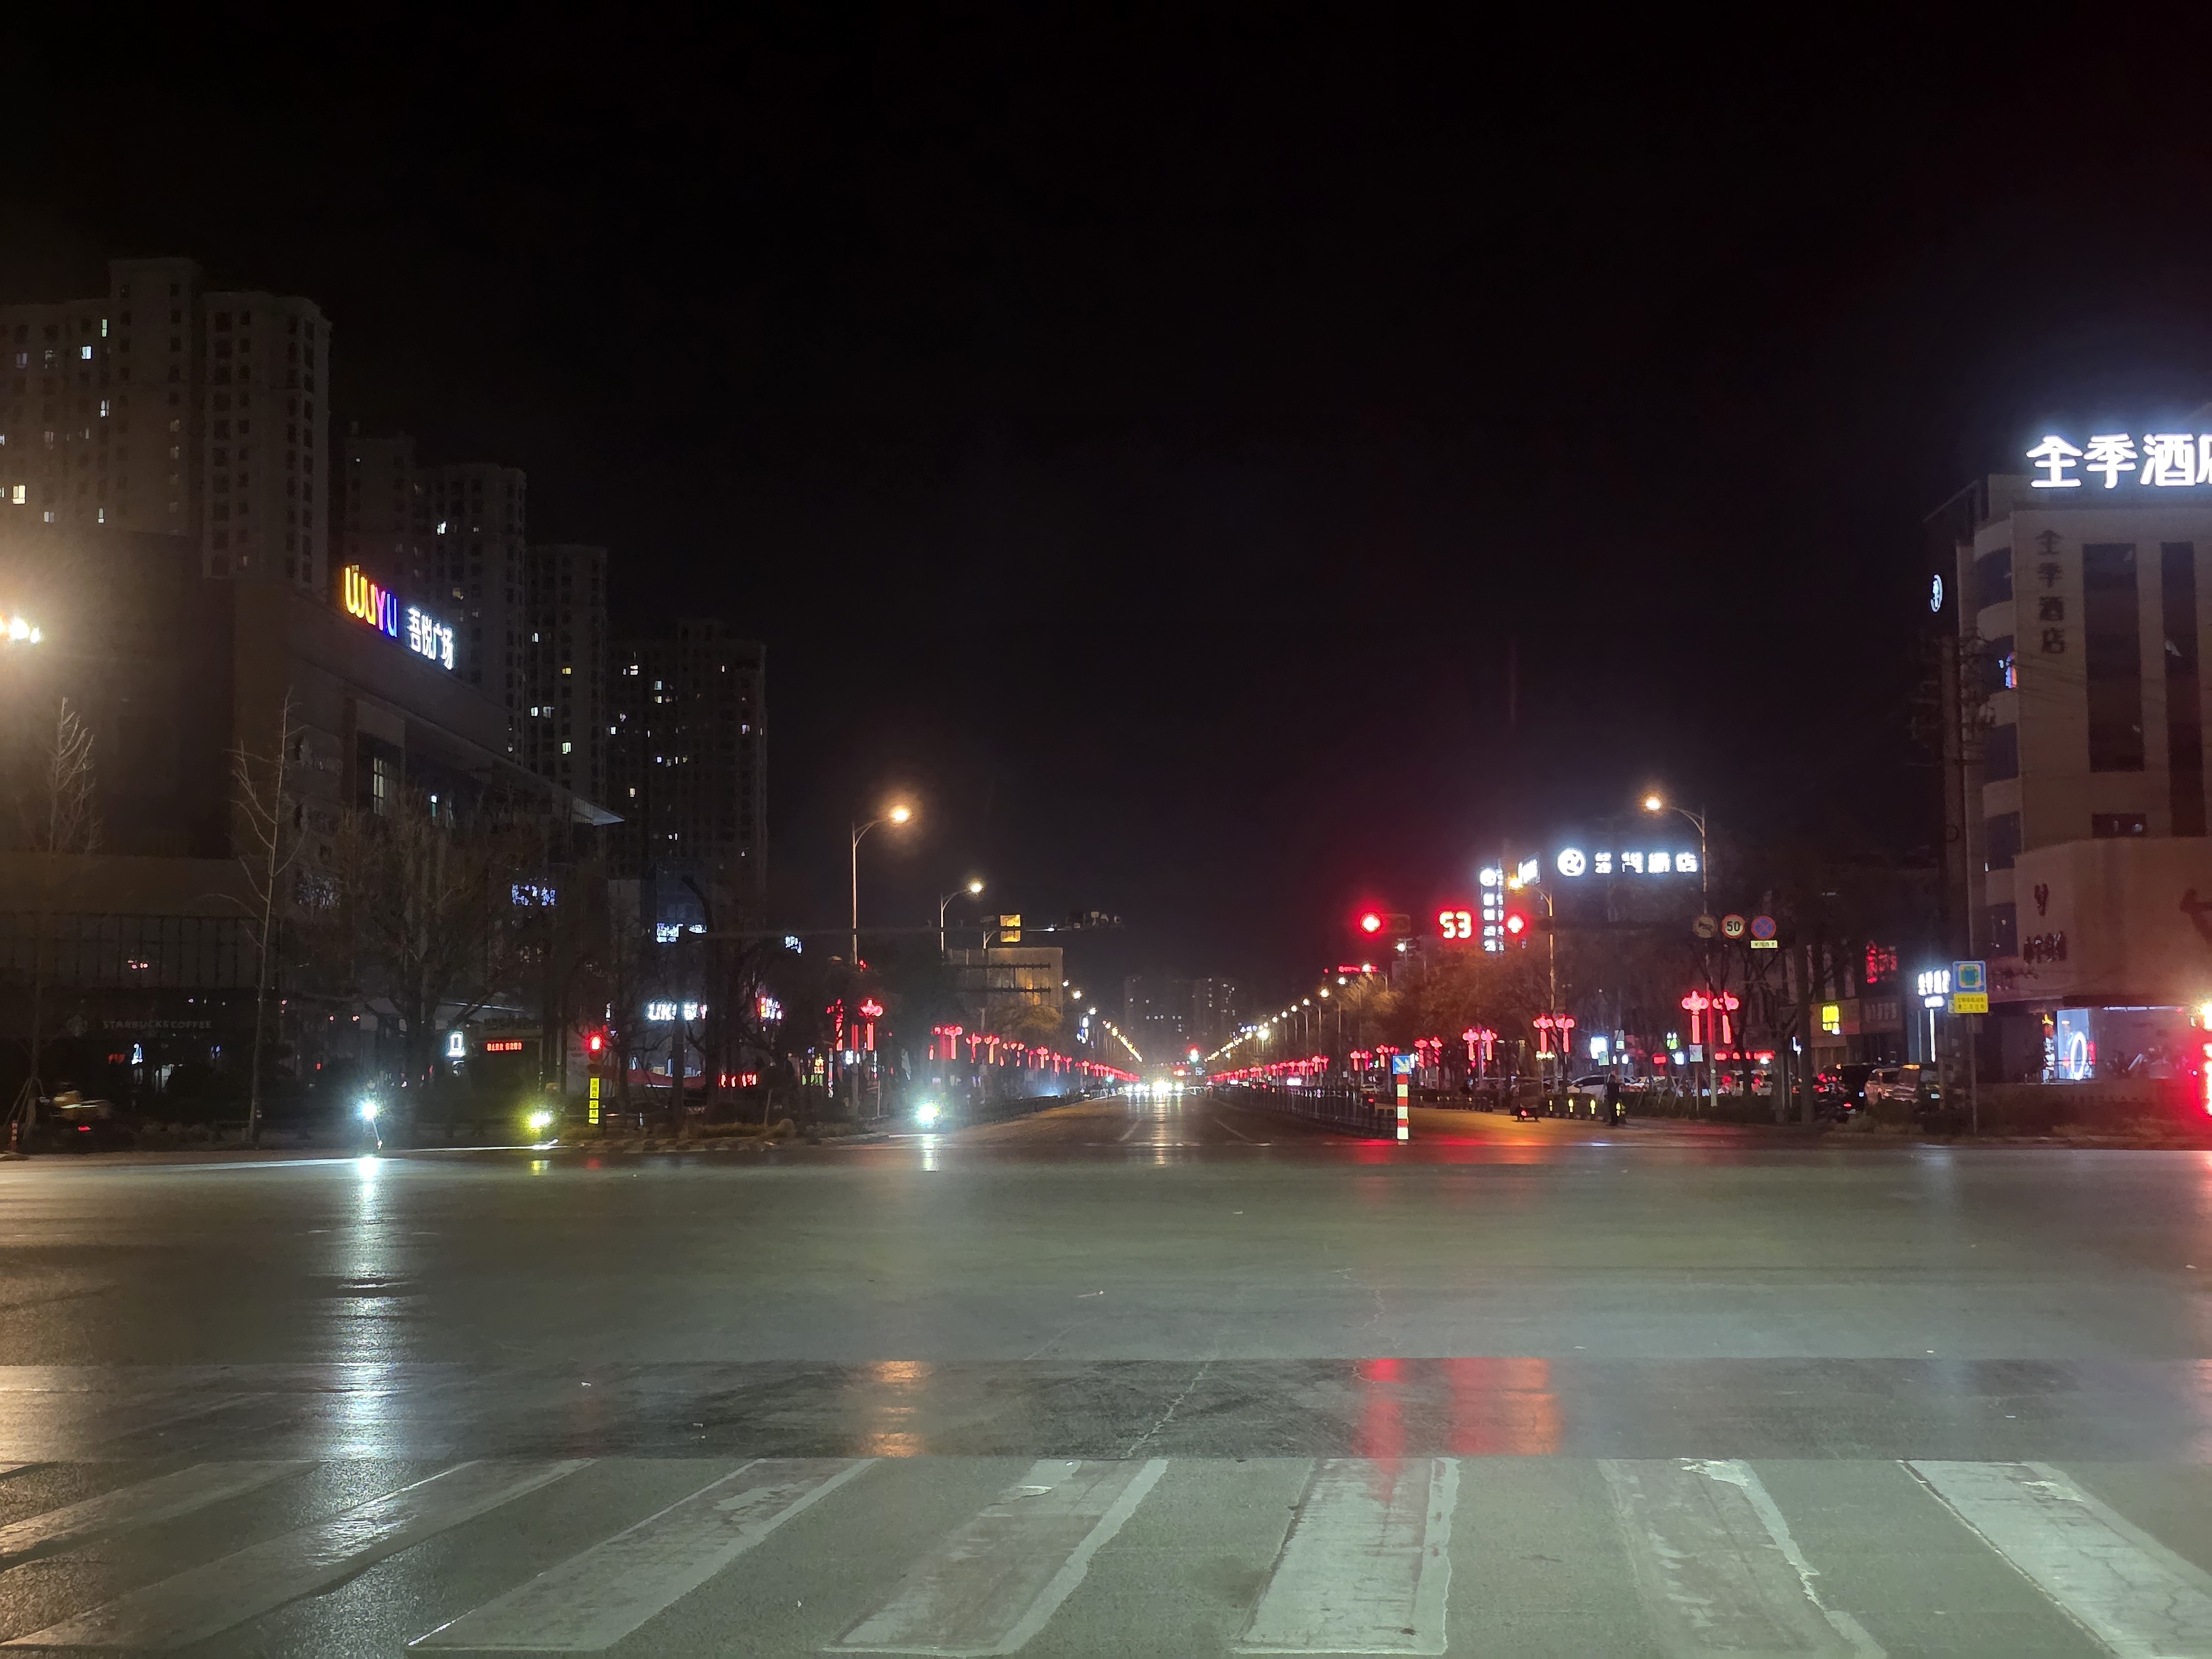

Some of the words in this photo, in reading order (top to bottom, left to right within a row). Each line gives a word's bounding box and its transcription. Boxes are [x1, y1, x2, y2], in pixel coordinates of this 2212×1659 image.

[2035, 529, 2065, 654] 全季酒店
[408, 607, 453, 670] 吾悦广场
[1439, 911, 1472, 938] 53
[1726, 921, 1741, 932] 50
